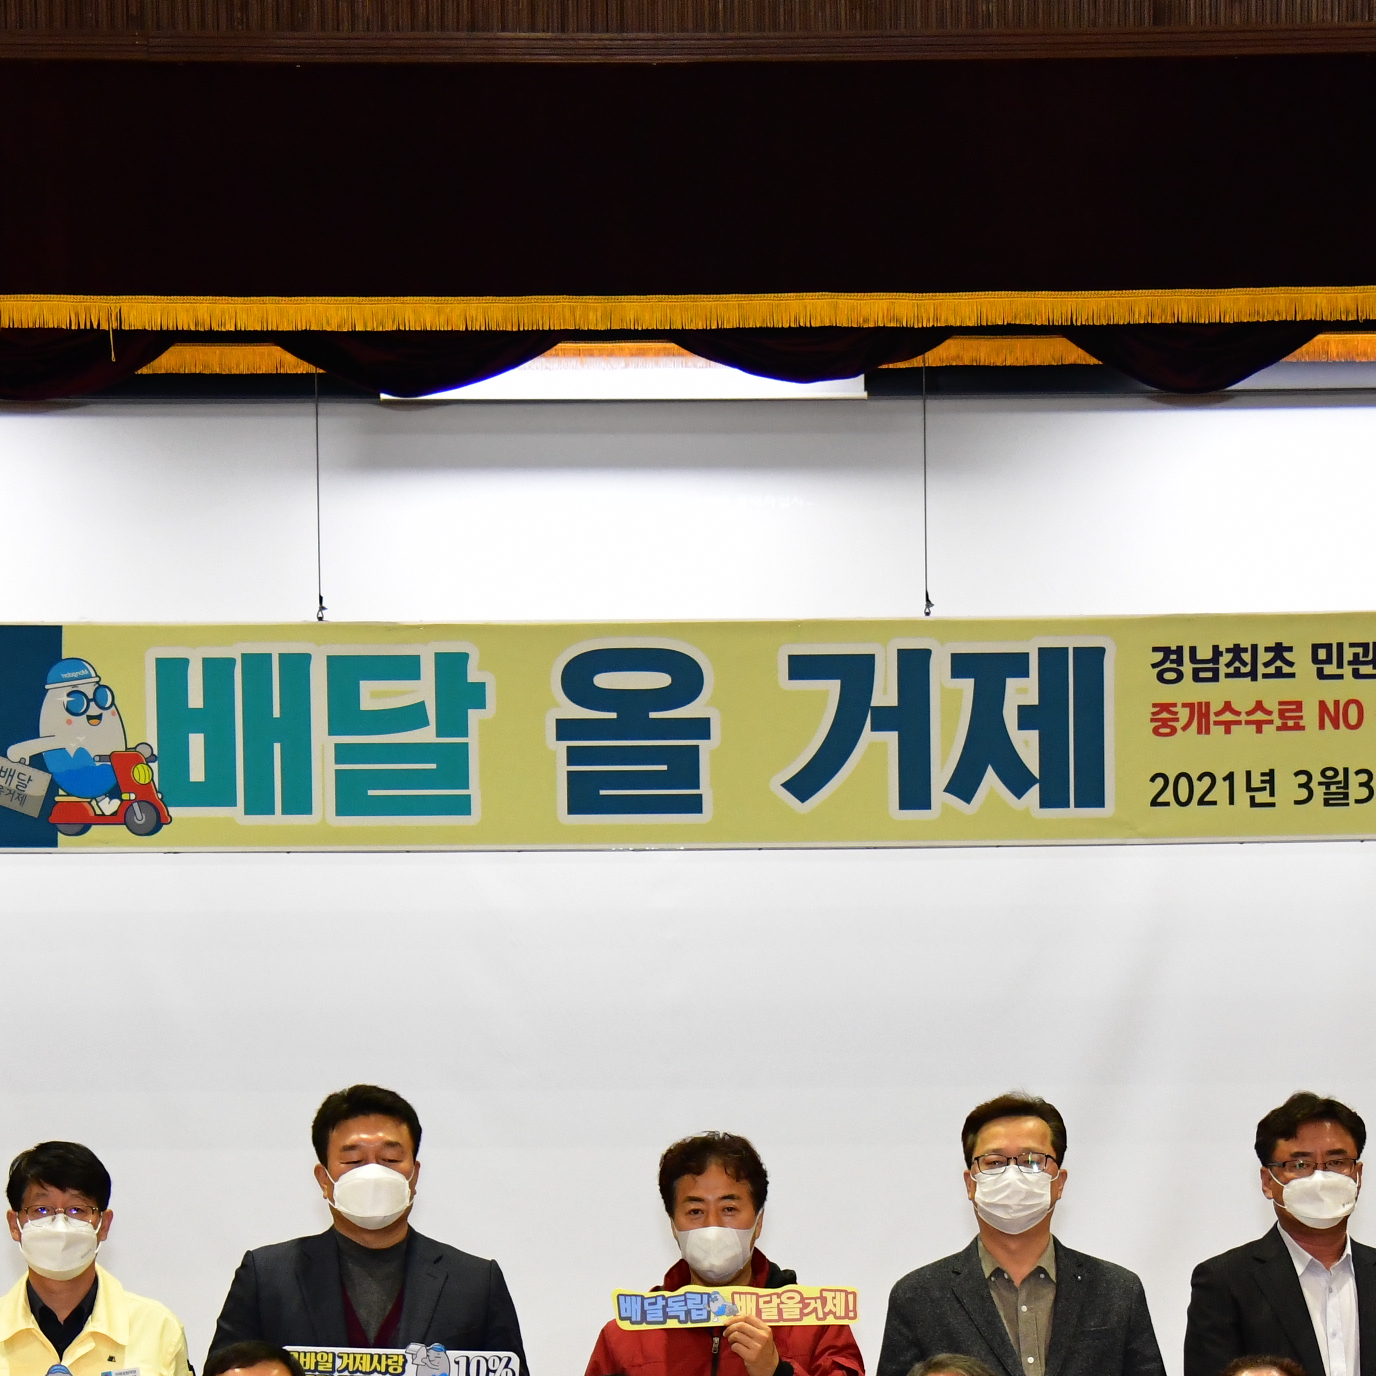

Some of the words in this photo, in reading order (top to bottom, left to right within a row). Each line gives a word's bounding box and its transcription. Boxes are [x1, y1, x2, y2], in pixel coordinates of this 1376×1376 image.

[1150, 642, 1296, 685] 경남최초
[155, 651, 486, 817] 배달
[556, 647, 711, 816] 올
[780, 646, 1106, 810] 거제
[1149, 700, 1306, 737] 중개수수료
[1318, 699, 1364, 732] NO
[1149, 769, 1277, 809] 2021년
[618, 1292, 712, 1324] 배달독립
[732, 1289, 857, 1323] 배달올거제!
[336, 1352, 405, 1376] 거제사랑
